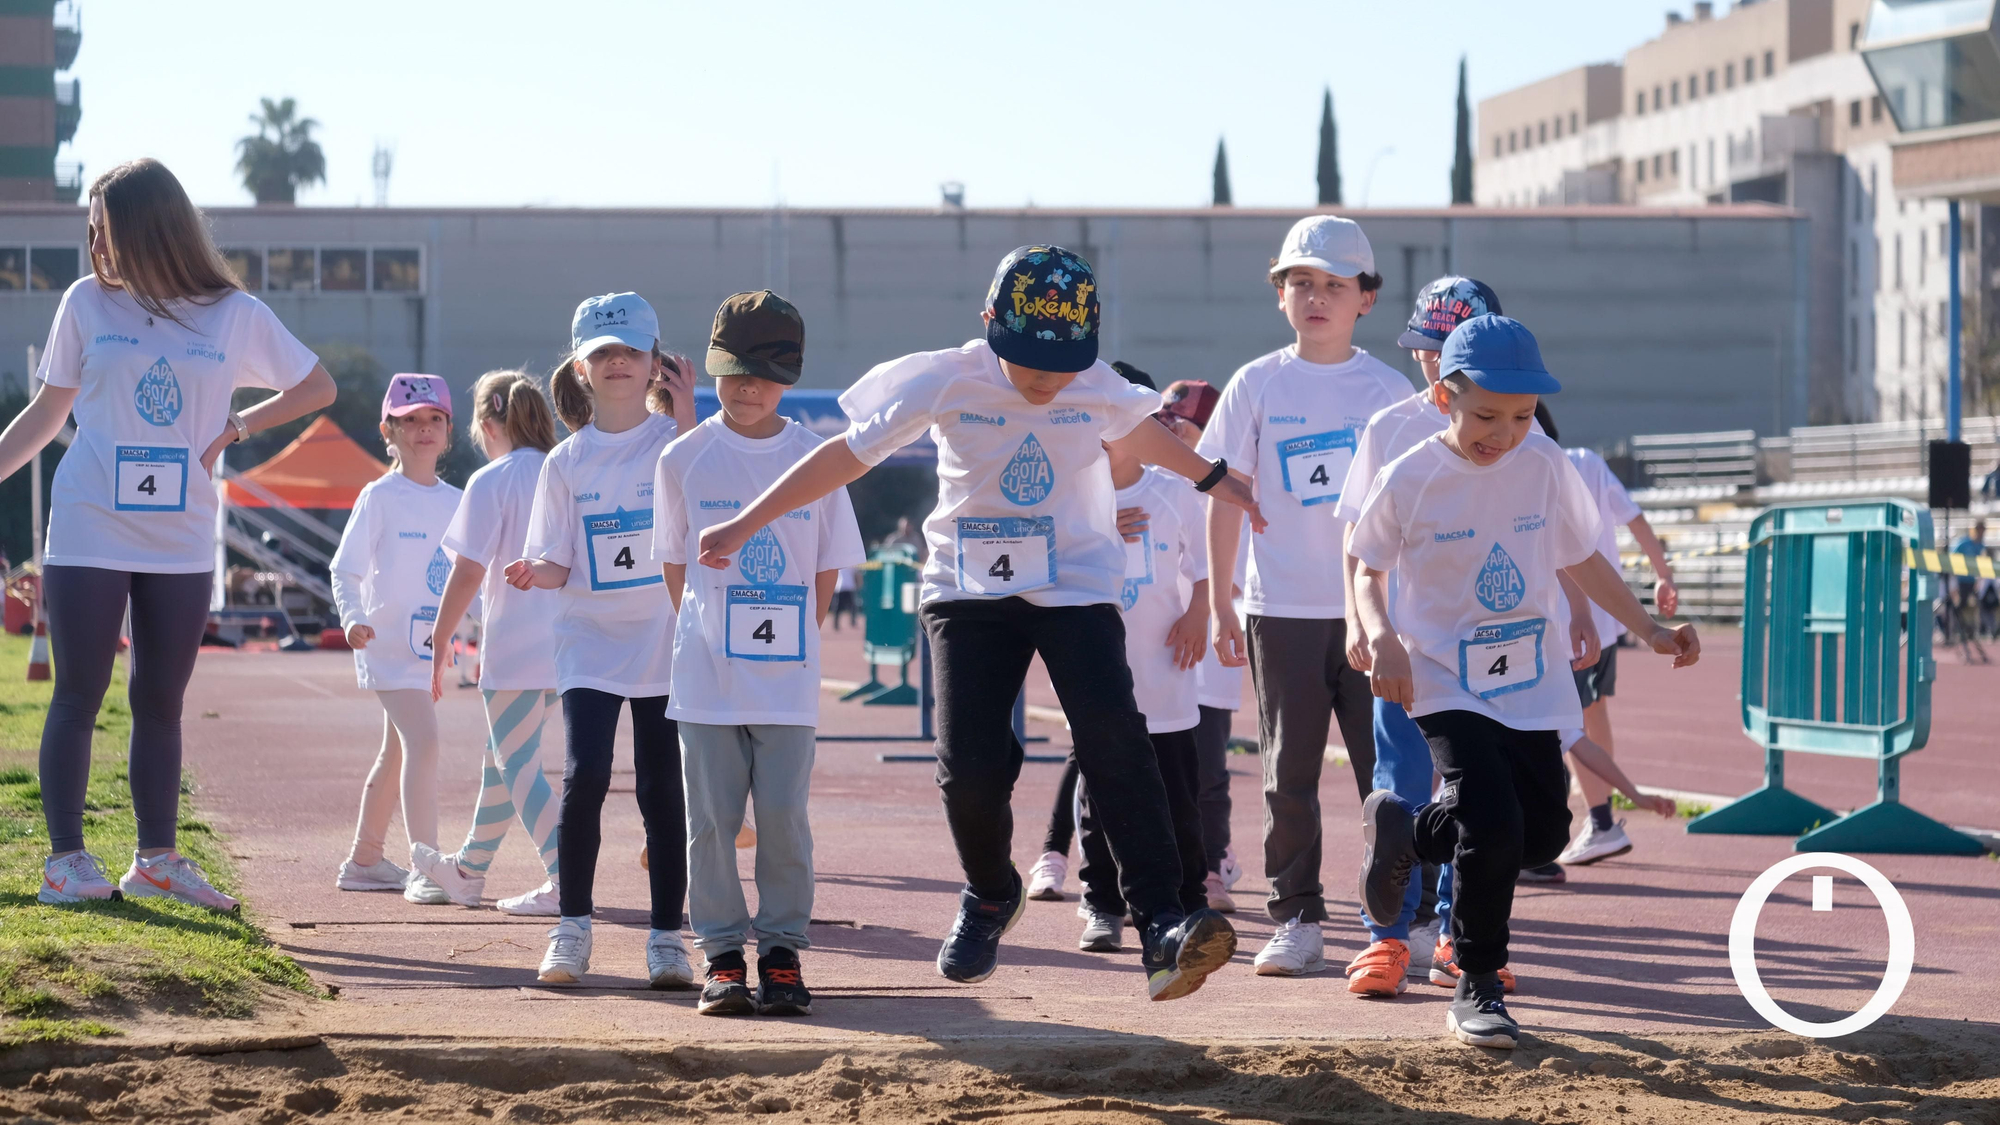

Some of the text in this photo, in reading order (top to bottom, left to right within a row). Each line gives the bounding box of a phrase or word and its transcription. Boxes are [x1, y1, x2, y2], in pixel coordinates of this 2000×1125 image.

[1425, 297, 1472, 319] MALIBU
[1432, 311, 1457, 323] BEACH
[1422, 320, 1457, 332] CALIFORN
[186, 347, 218, 360] unicef
[145, 363, 174, 387] CADA
[134, 391, 177, 424] CUEN
[142, 383, 179, 411] GOTA
[1050, 412, 1081, 425] unicef
[1015, 441, 1044, 462] CADA
[1010, 461, 1050, 484] GOTA
[1309, 464, 1330, 486] 4
[137, 474, 157, 496] 4
[636, 487, 654, 498] unic
[1000, 471, 1046, 502] CUENTA
[700, 500, 733, 508] EMACSA
[591, 521, 614, 529] EMACSA
[1434, 530, 1467, 541] EMACSA
[613, 546, 635, 570] 4
[747, 545, 783, 567] GOTA
[1485, 549, 1512, 571] CADA
[740, 554, 780, 583] CUENTA
[988, 553, 1014, 582] 4
[1483, 568, 1522, 592] GOTA
[1476, 581, 1520, 609] CUENTA
[752, 619, 776, 644] 4
[1488, 654, 1509, 676] 4
